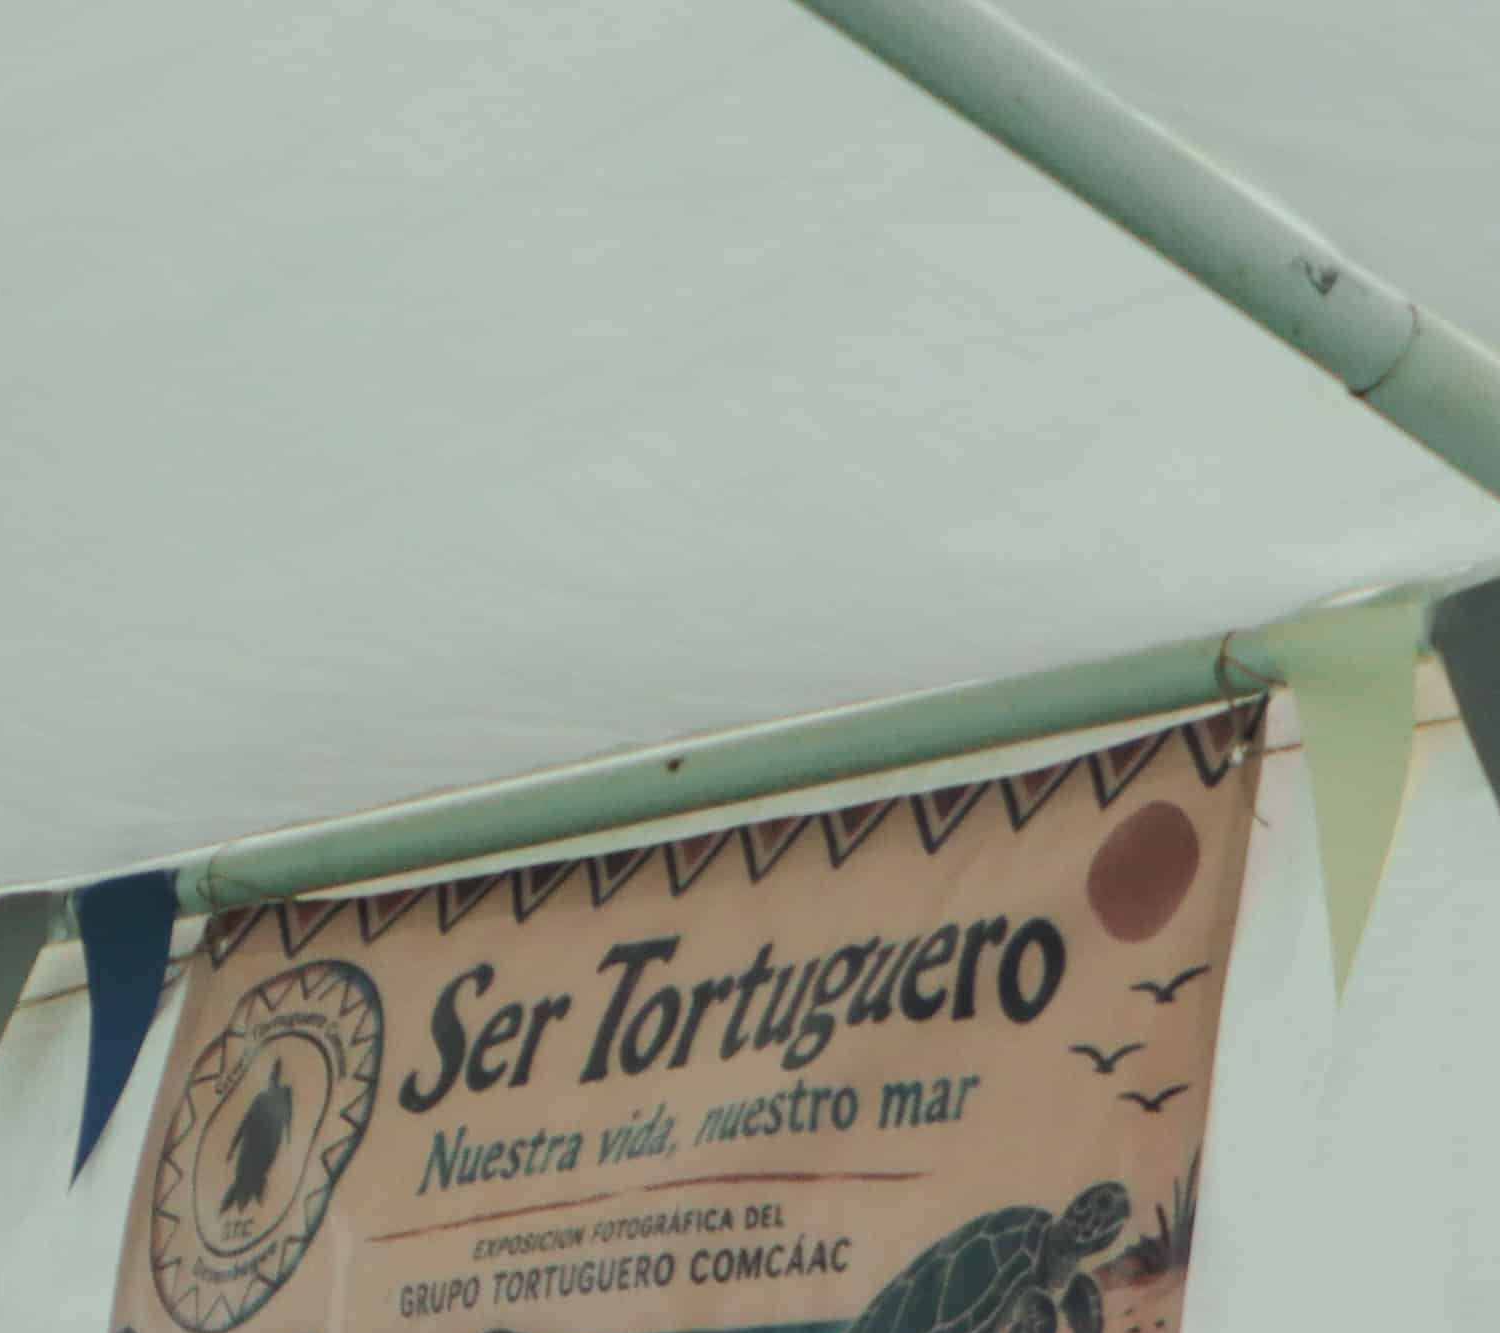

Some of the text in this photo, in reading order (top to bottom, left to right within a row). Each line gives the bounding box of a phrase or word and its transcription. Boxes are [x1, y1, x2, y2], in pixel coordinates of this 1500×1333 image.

[399, 961, 571, 1114] Ser
[579, 914, 1066, 1084] Tortuguero
[417, 1074, 980, 1195] Nuestra vida, nuestro mar
[744, 1204, 785, 1230] DEL
[400, 1232, 853, 1319] GRUPO TORTUGUERO COMCÁAC
